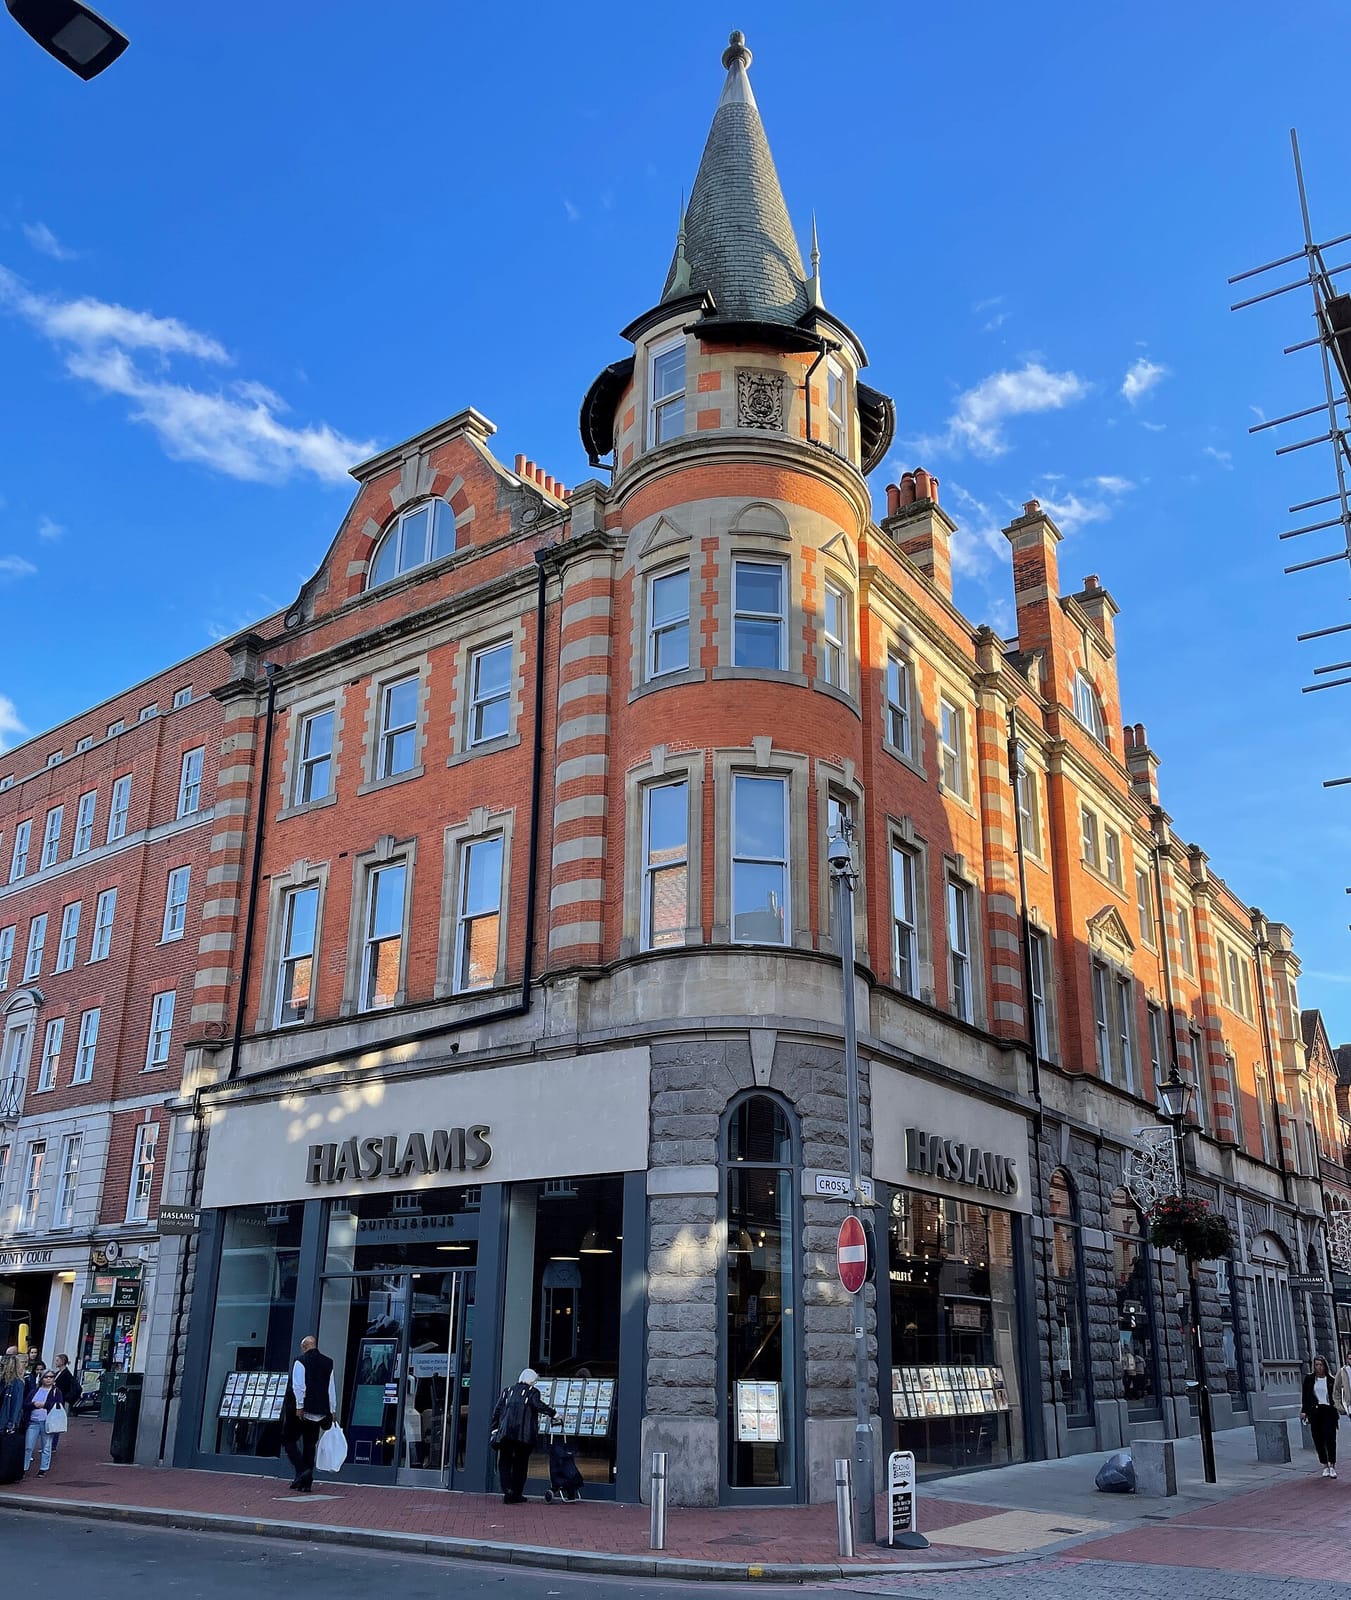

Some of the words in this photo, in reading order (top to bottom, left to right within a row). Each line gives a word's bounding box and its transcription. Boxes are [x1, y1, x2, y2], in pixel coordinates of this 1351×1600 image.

[305, 1124, 492, 1183] HASLAMS
[905, 1127, 1018, 1195] HASLAMS
[820, 1180, 846, 1191] CROSS
[161, 1211, 194, 1219] HASLAMS
[26, 1250, 53, 1263] COURT
